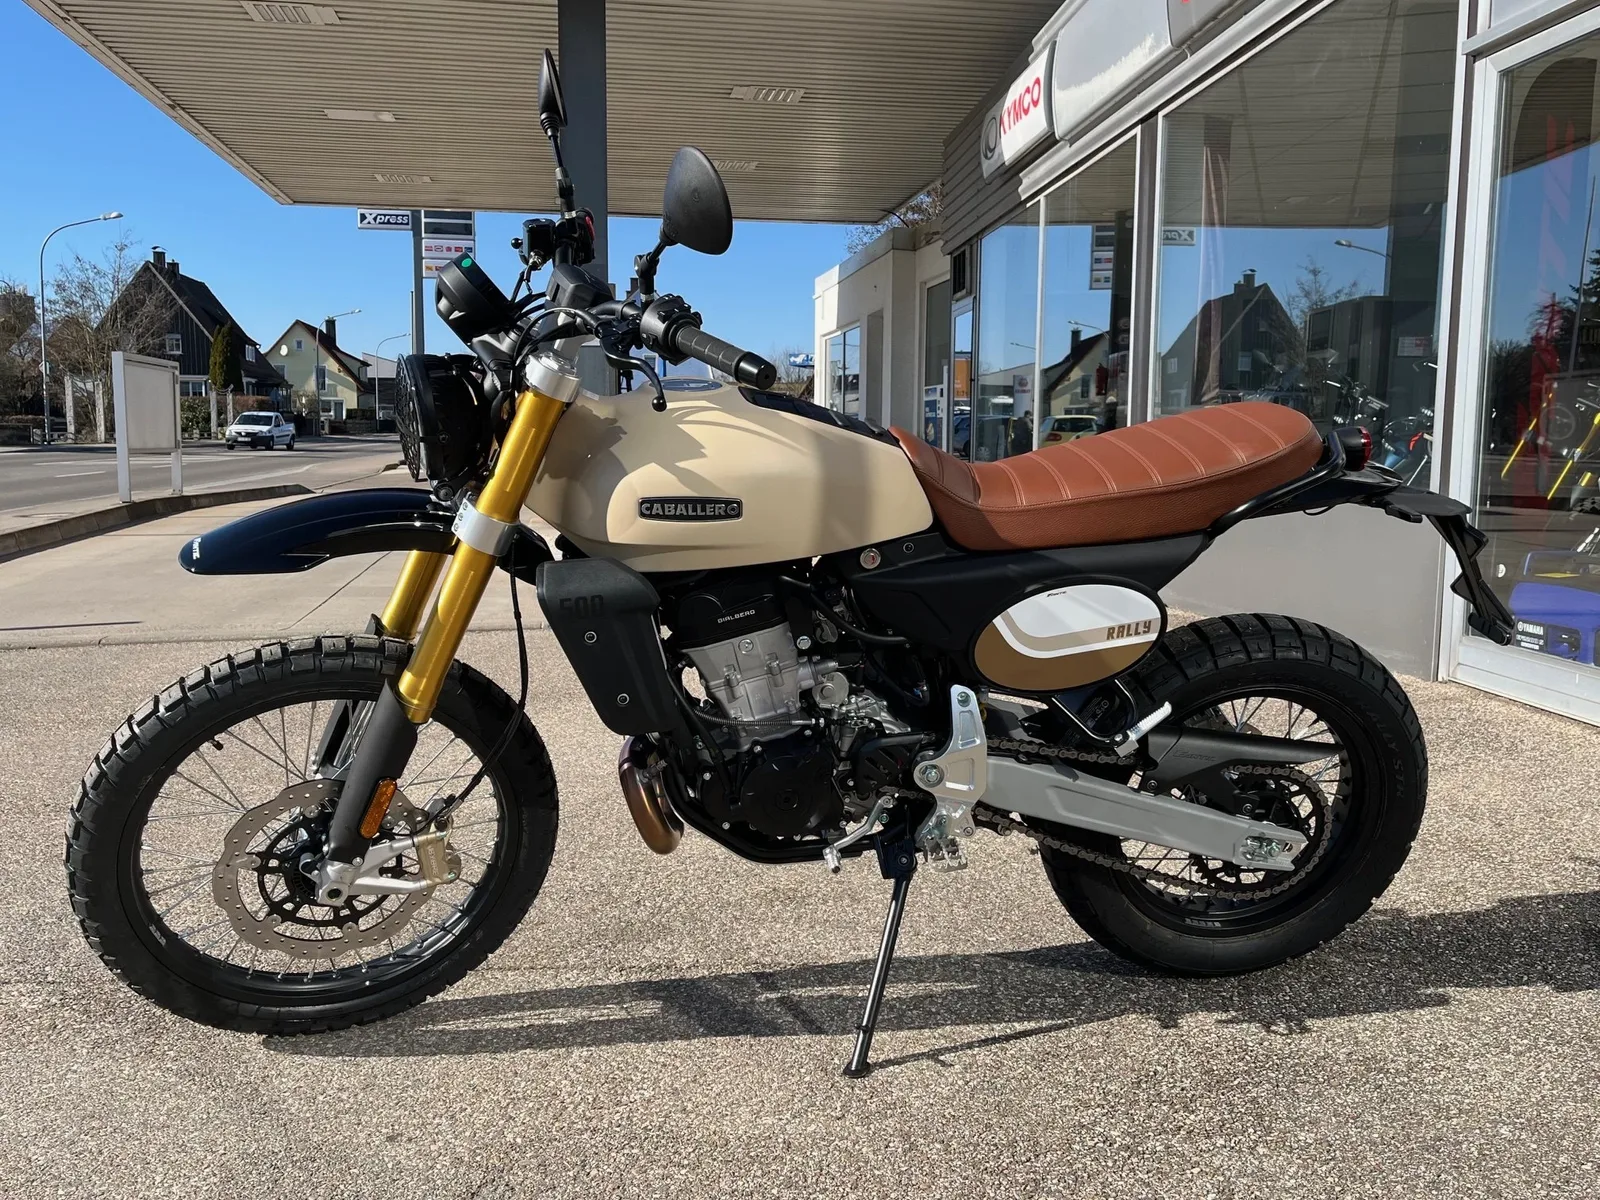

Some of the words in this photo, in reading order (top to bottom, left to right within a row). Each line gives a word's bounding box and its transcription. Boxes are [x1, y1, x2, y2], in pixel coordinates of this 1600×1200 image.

[1000, 77, 1041, 135] KYMCO
[361, 213, 409, 224] Xpress
[641, 503, 739, 516] CABALLERO
[1106, 620, 1152, 641] RALLY
[1523, 622, 1544, 636] YAMAHA
